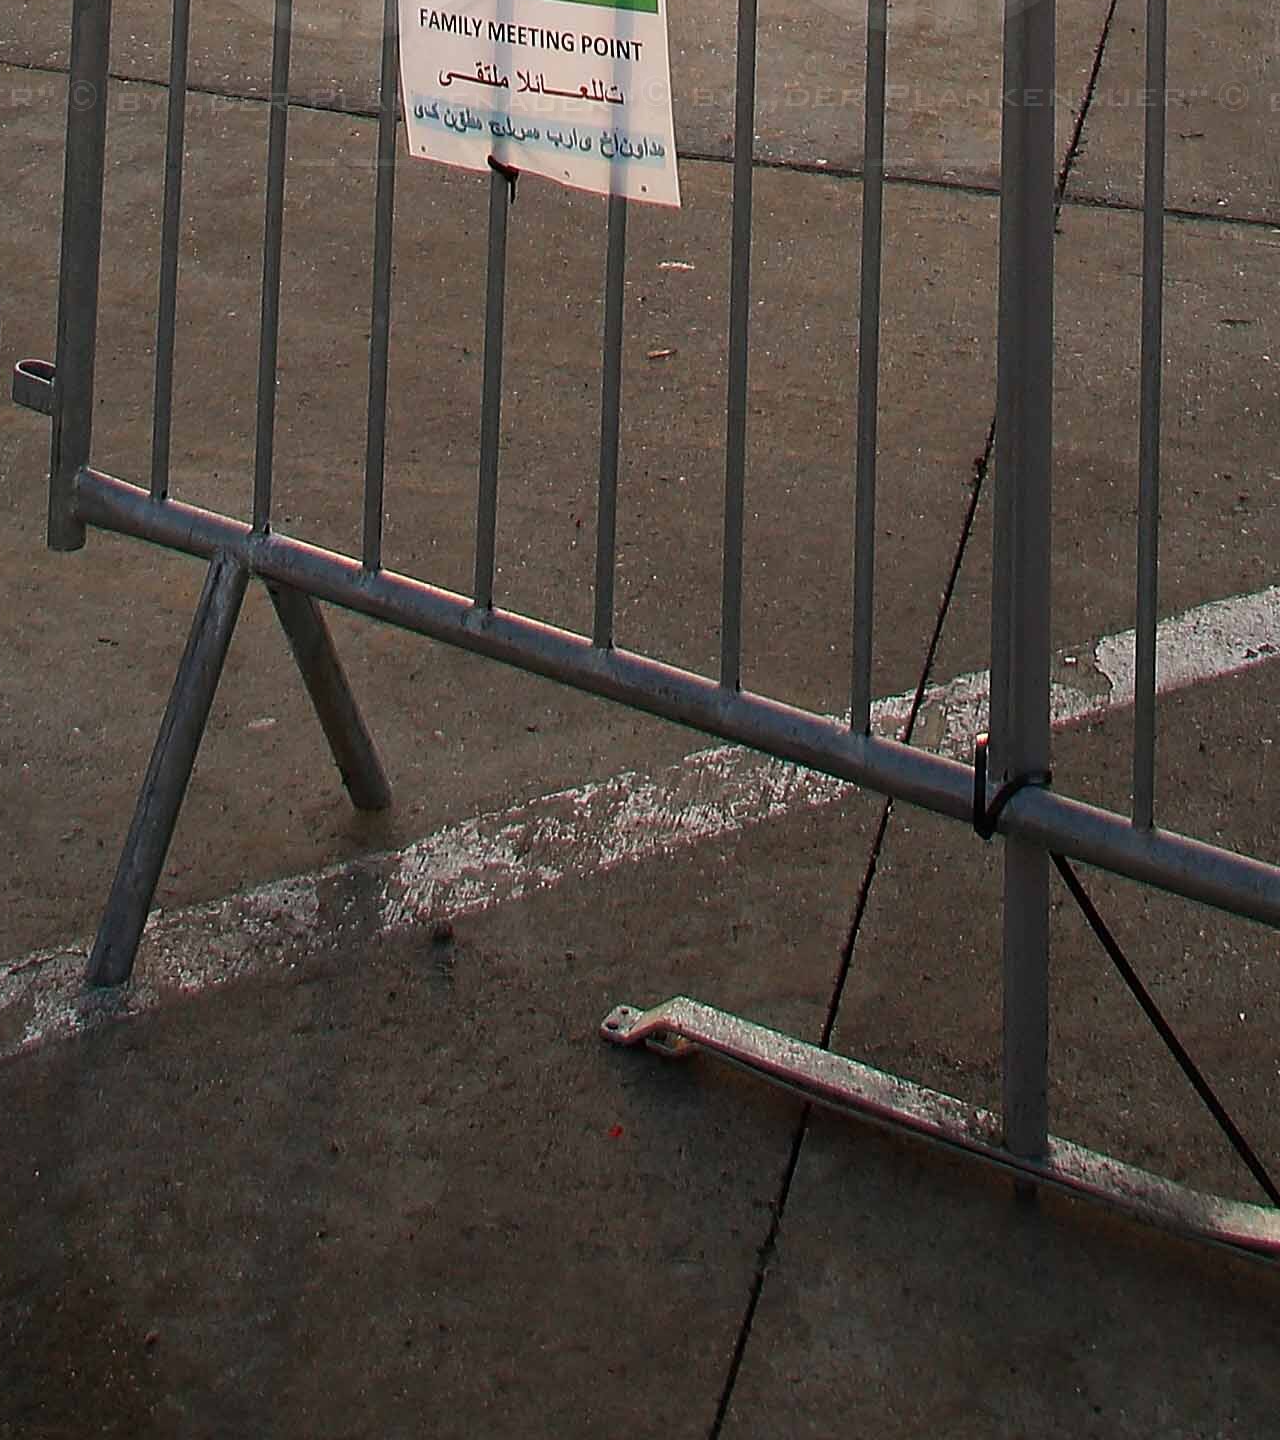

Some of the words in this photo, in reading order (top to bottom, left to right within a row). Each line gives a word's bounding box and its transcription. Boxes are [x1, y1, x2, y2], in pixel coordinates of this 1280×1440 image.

[420, 8, 482, 38] FAMILY
[488, 22, 575, 52] MEETING
[582, 36, 642, 61] POINT
